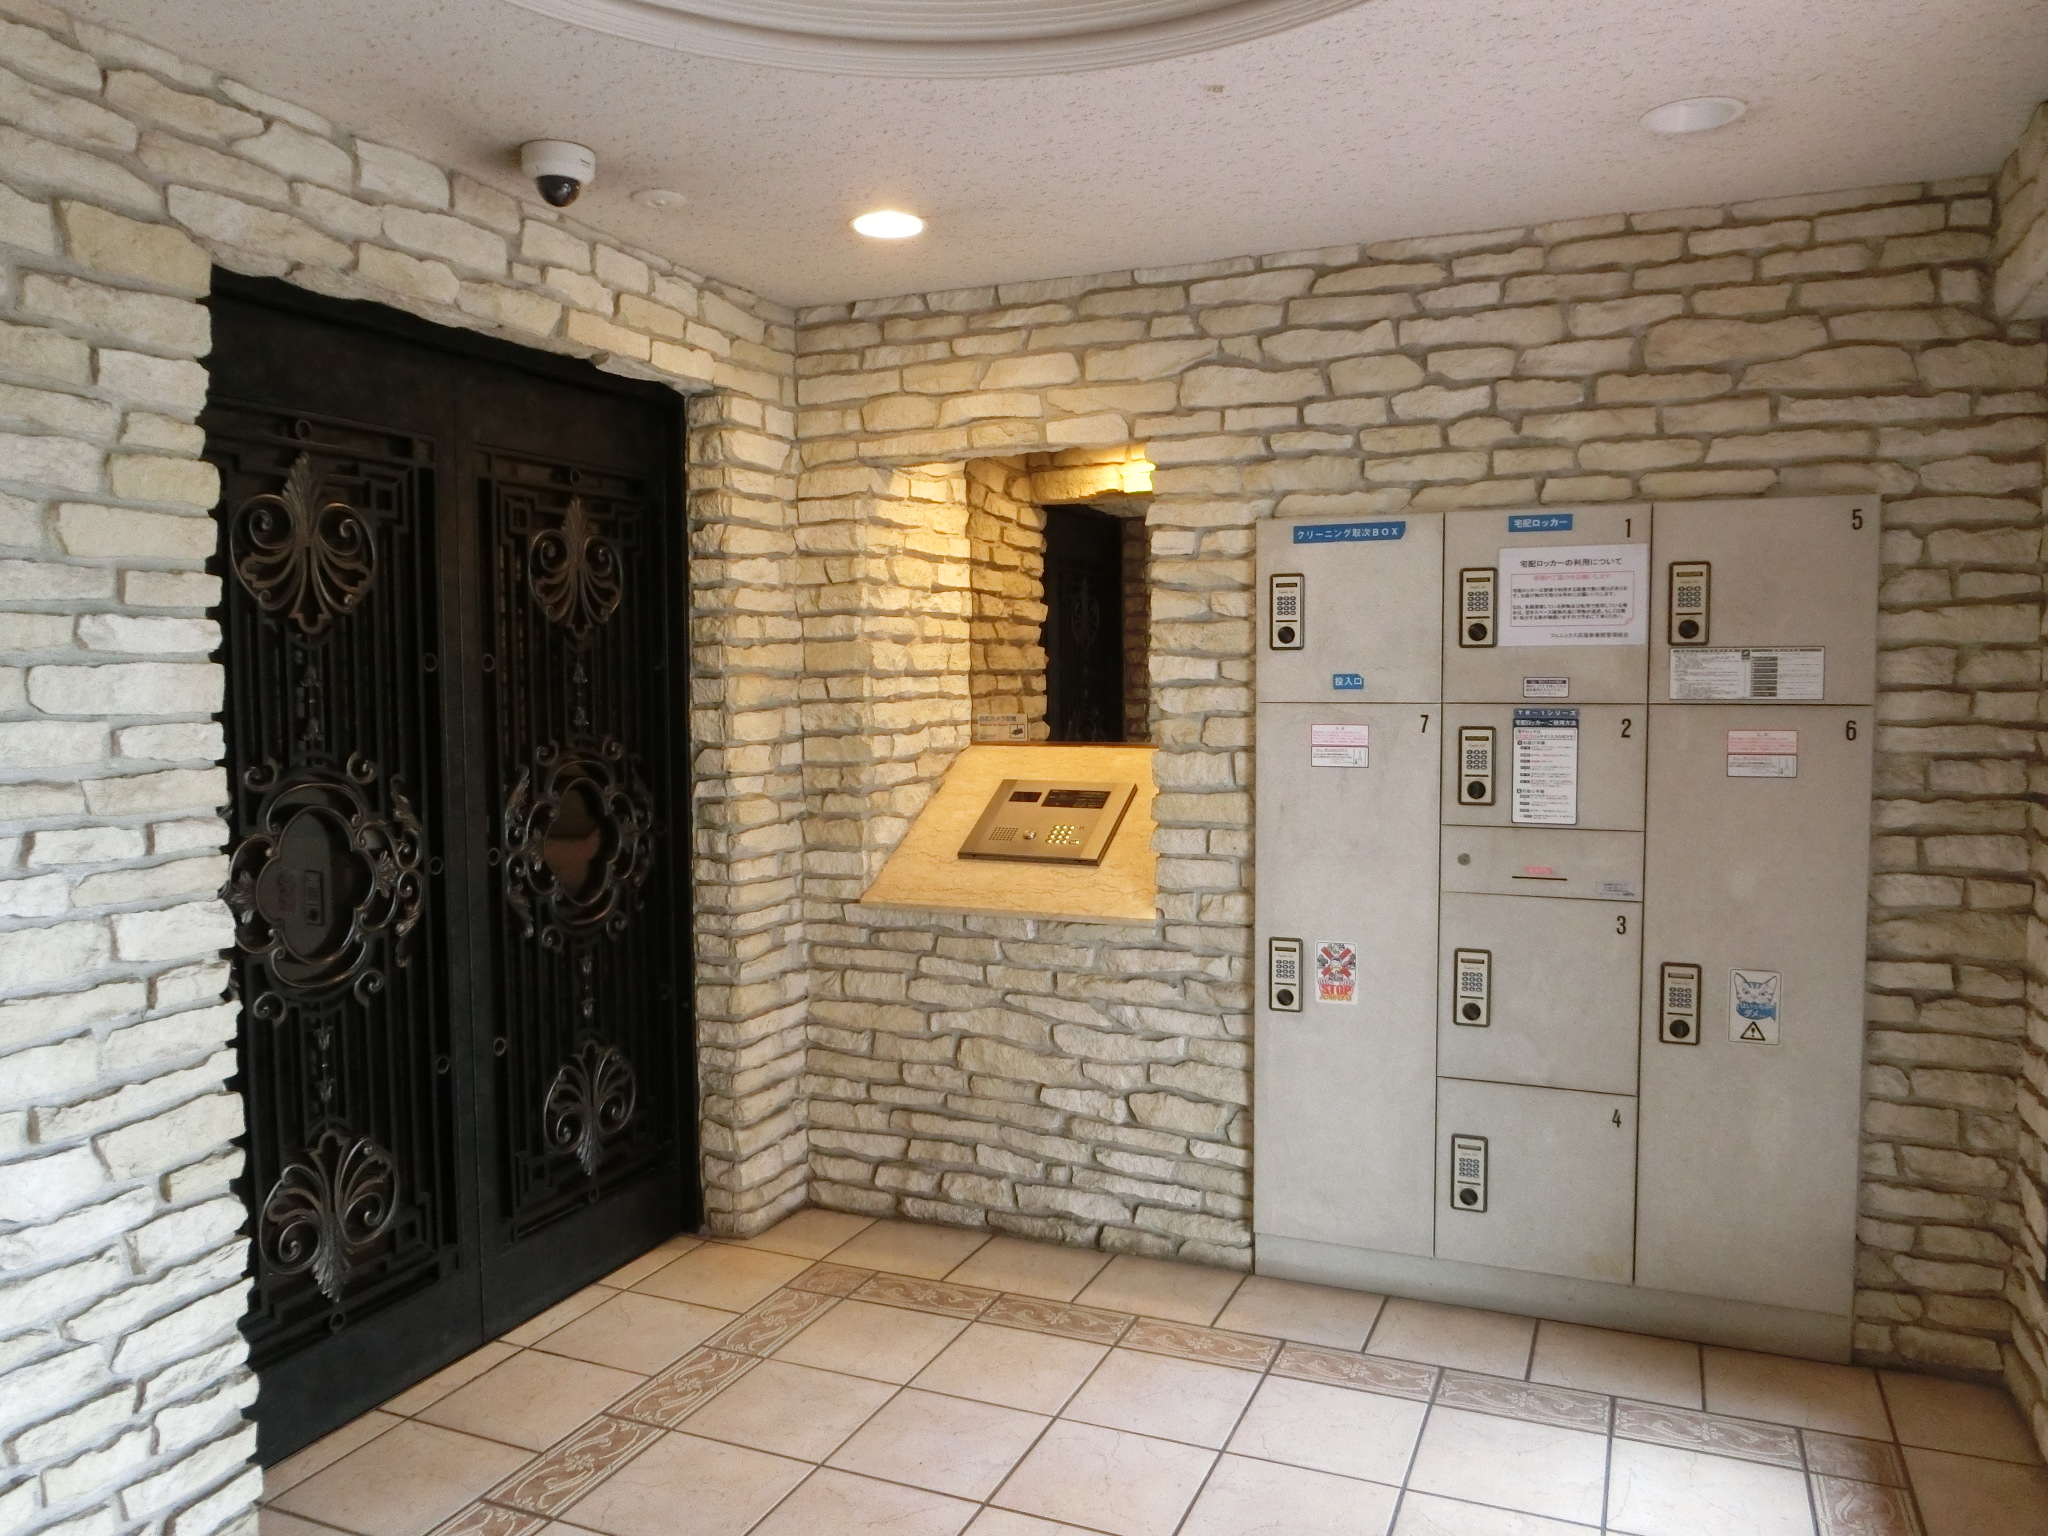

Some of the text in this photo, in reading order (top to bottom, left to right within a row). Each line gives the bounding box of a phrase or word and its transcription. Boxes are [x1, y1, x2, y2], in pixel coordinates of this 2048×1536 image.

[1513, 517, 1568, 529] 宅配ロッカー
[1625, 518, 1631, 538] 1
[1852, 508, 1863, 530] 5
[1297, 527, 1398, 540] クリーニング取次BOX
[1520, 557, 1622, 568] 宅配ロッカーの利用について
[1334, 677, 1362, 686] 投入口
[1420, 714, 1429, 733] 7
[1621, 718, 1631, 738] 2
[1846, 720, 1857, 741] 6
[1616, 915, 1627, 935] 3
[1321, 984, 1351, 995] STOP
[1612, 1109, 1622, 1128] 4
